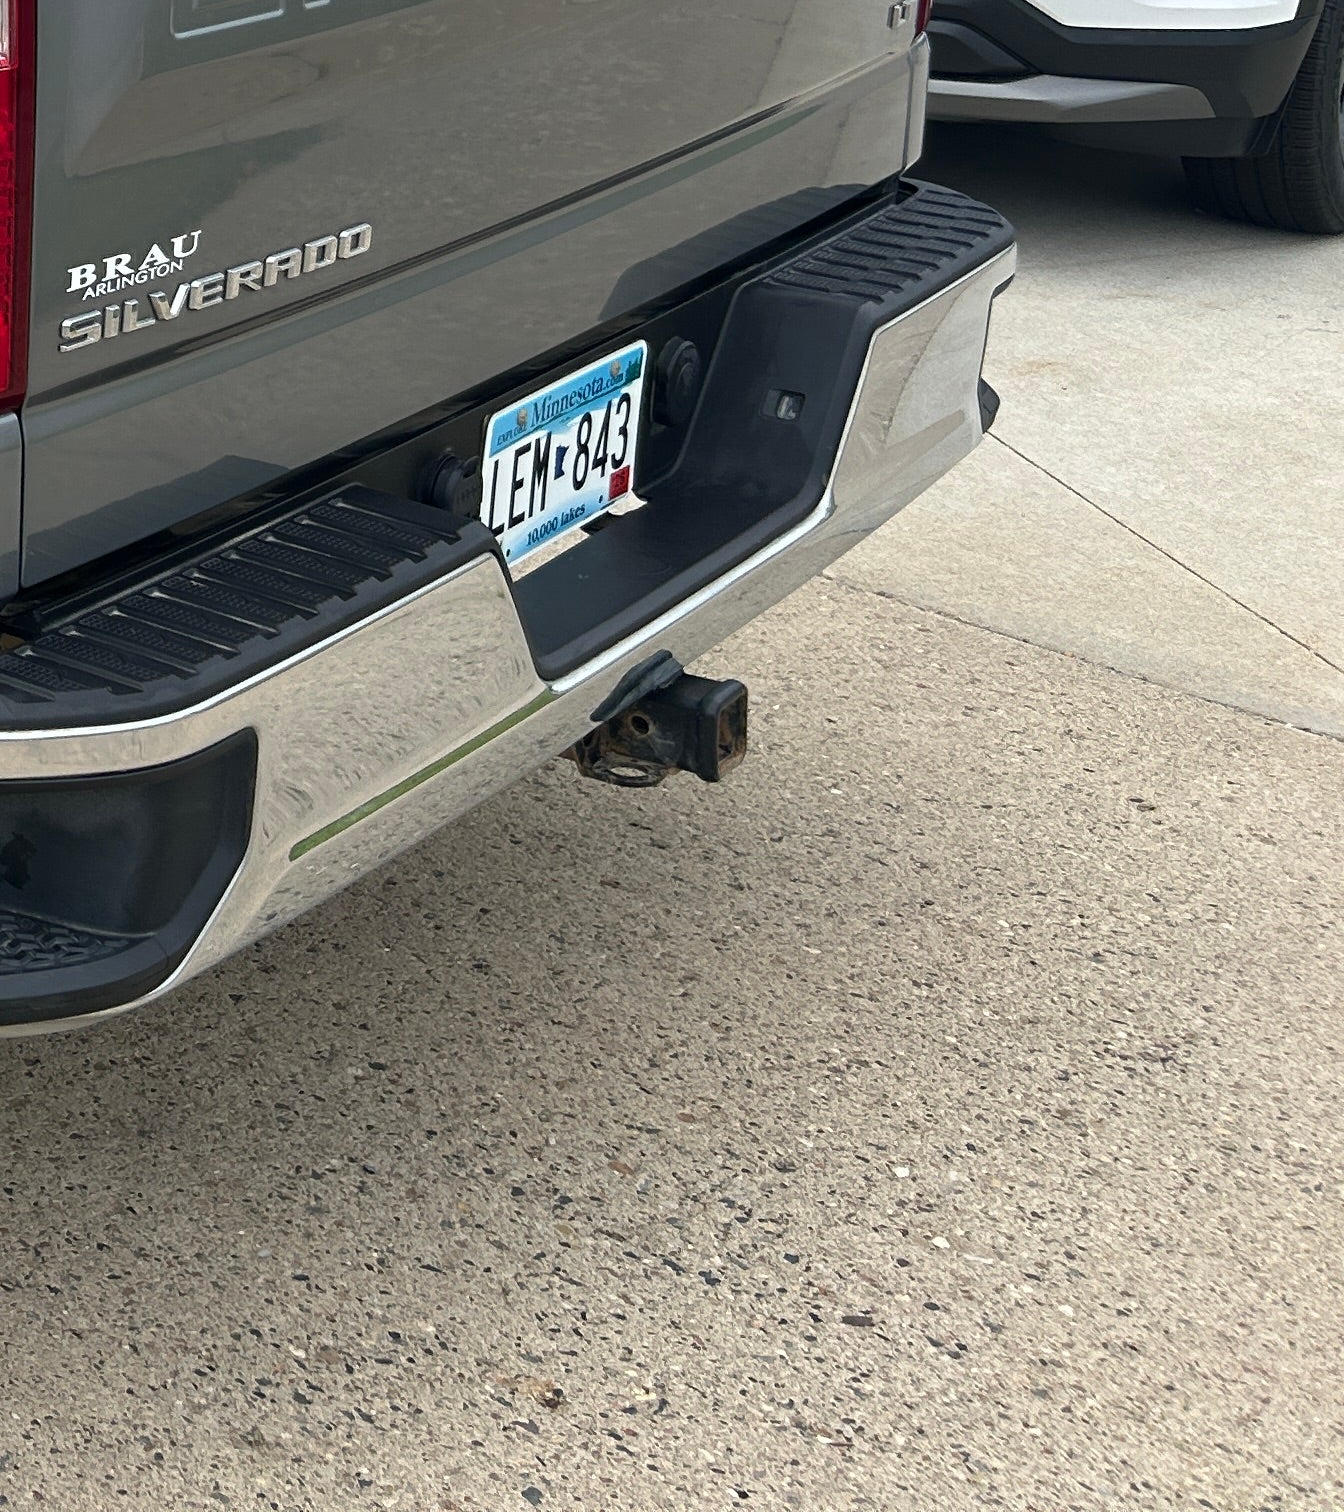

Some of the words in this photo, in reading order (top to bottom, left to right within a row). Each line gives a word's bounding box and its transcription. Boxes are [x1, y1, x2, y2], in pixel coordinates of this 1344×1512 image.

[58, 221, 373, 353] SILVERADO
[65, 229, 202, 294] BRAU
[81, 258, 184, 301] ARLINGTON
[487, 430, 552, 538] LEM
[572, 392, 631, 491] 843
[526, 515, 560, 546] 10,000
[560, 503, 586, 526] lakes
